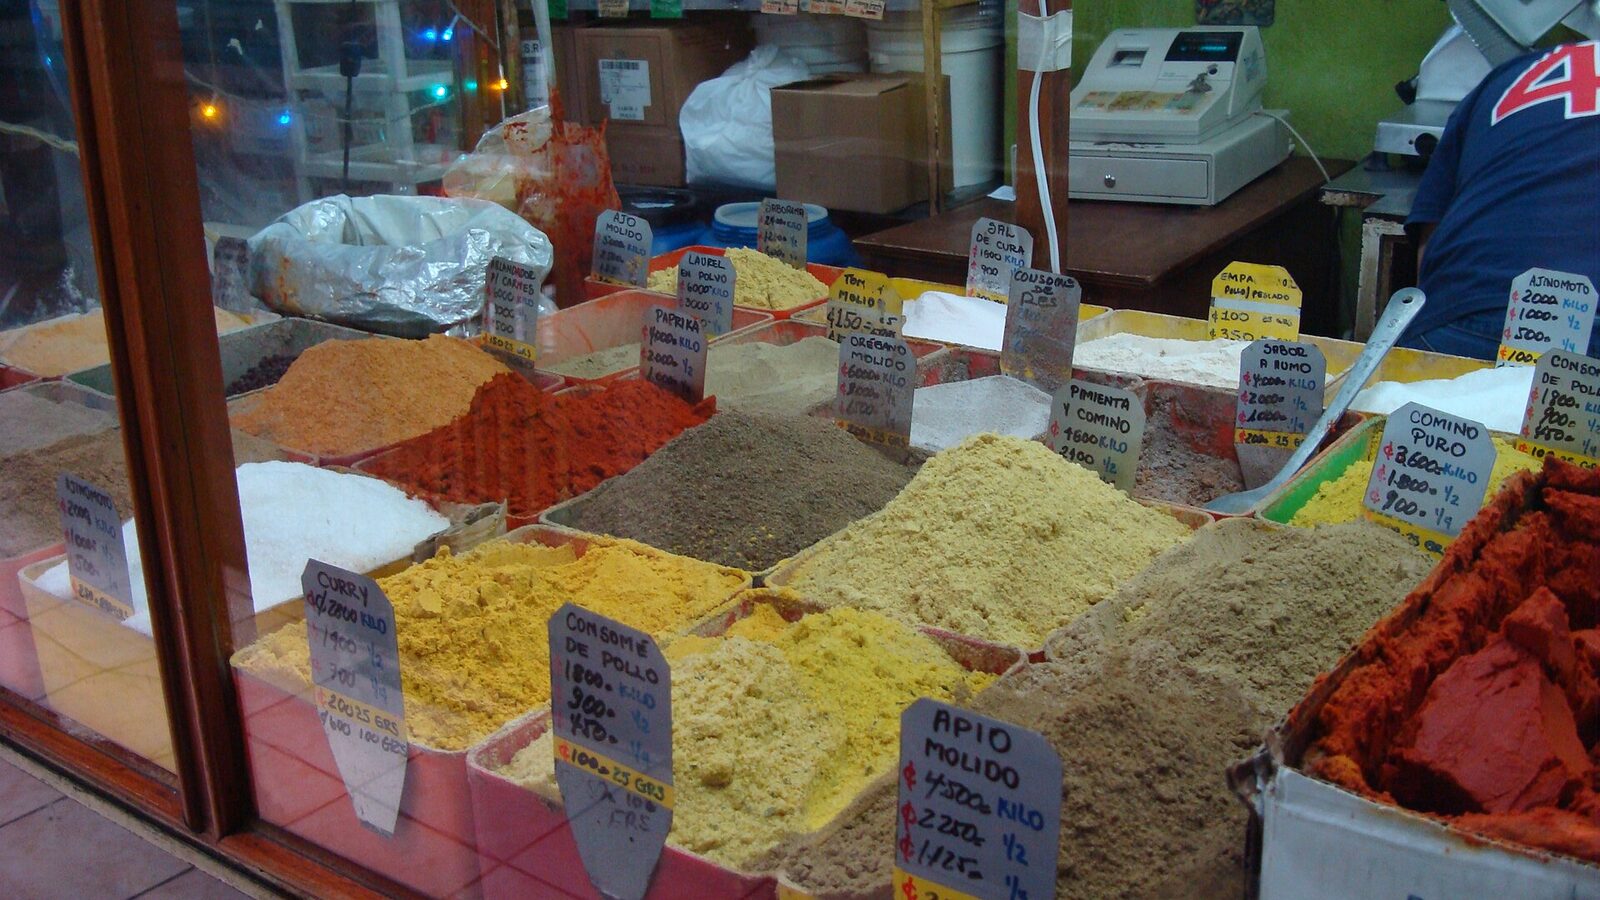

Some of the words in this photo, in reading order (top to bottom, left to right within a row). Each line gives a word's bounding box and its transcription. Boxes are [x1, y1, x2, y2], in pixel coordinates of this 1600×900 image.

[1491, 40, 1600, 127] 4
[613, 212, 636, 227] AJO
[987, 222, 1015, 238] SAL
[606, 223, 643, 241] MOLIDO
[976, 233, 990, 245] DE
[996, 240, 1025, 256] CURA
[688, 255, 725, 270] LAUREL
[1004, 254, 1025, 268] KILO
[681, 269, 691, 278] EN
[698, 271, 727, 283] POLVO
[1529, 274, 1590, 295] AJINOMOTO
[712, 287, 729, 298] KILO
[1031, 285, 1054, 296] DE
[1562, 298, 1589, 313] KILO
[655, 308, 700, 333] PAPRIKA
[1567, 314, 1580, 330] 1/2
[679, 336, 701, 353] KILO
[1263, 344, 1308, 357] SABOR
[681, 357, 694, 377] 1/2
[850, 351, 906, 371] MOLIDO
[1260, 358, 1268, 369] A
[882, 372, 907, 388] KILO
[1288, 378, 1316, 391] KILO
[1541, 372, 1560, 386] DE
[1070, 384, 1130, 411] PIMIENTA
[1063, 403, 1070, 416] Y
[1077, 408, 1131, 434] COMINO
[1409, 410, 1479, 440] COMINO
[1098, 435, 1128, 454] KILO
[1411, 427, 1466, 457] PURO
[1103, 456, 1118, 475] 1/2
[1443, 462, 1478, 484] KILO
[1444, 484, 1460, 507] 1/2
[316, 571, 369, 607] CURRY
[360, 610, 387, 635] KILO
[366, 638, 384, 671] 1/2
[565, 637, 588, 659] DE
[602, 650, 659, 685] POLLO
[618, 681, 657, 710] KILO
[375, 714, 399, 737] GRS
[630, 709, 652, 735] 1/2
[933, 709, 1012, 754] APIO
[924, 737, 1020, 790] MOLIDO
[612, 766, 630, 787] 25
[634, 776, 665, 802] GRS
[996, 796, 1045, 832] KILO
[1001, 831, 1029, 868] 1/2
